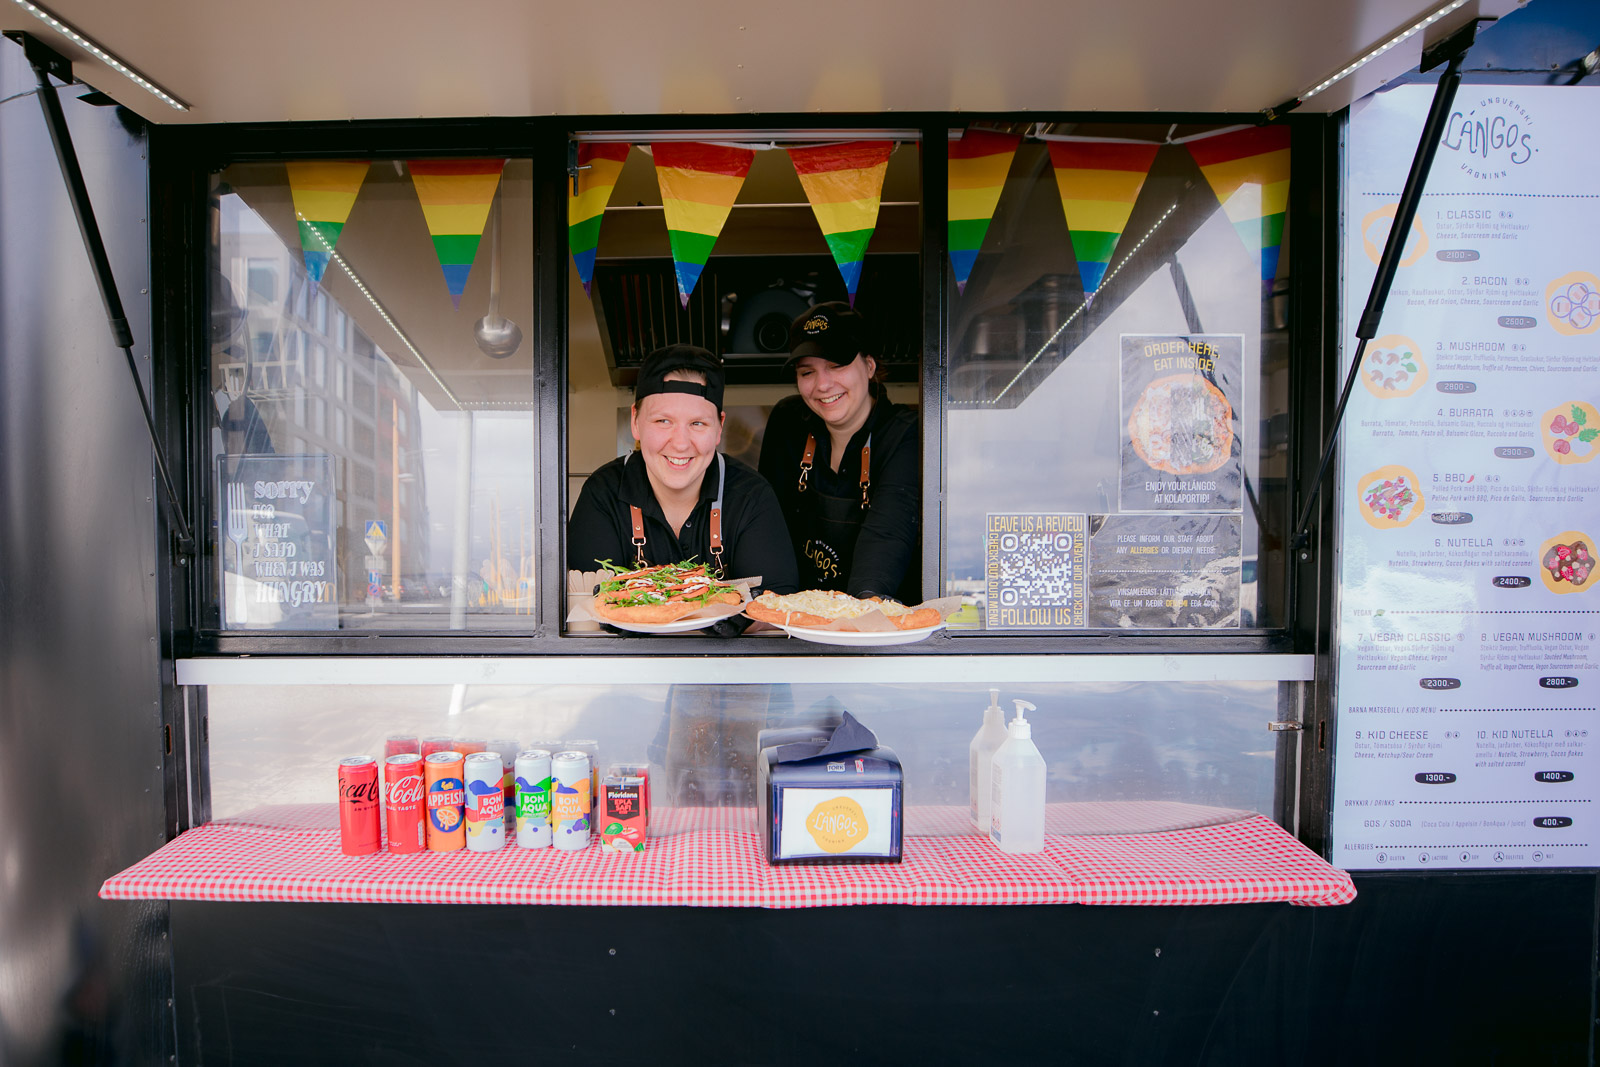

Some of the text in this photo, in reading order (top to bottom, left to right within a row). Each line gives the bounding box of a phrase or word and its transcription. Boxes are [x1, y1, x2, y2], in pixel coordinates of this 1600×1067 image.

[1480, 97, 1533, 126] UNGVERSKI
[1461, 163, 1506, 180] VAGNINN
[1447, 210, 1492, 219] CLASSIC
[1462, 276, 1507, 285] 2. BACON
[1144, 342, 1220, 359] ORDER HERE,
[1436, 342, 1505, 351] 3. MUSHROOM
[1154, 357, 1216, 372] EAT INSIDE!
[1438, 408, 1494, 417] 4. BURRATA
[1433, 474, 1465, 482] 5. BBQ
[1146, 479, 1216, 491] ENJOY YOUR LÁNGOS
[254, 480, 315, 504] sorry
[1154, 495, 1164, 504] AT
[252, 504, 275, 520] FOR
[988, 516, 1083, 532] LEAVE US A REVIEW
[254, 523, 291, 538] WHAT
[1178, 534, 1193, 542] STAFF
[1434, 538, 1492, 547] 6. NUTELLA
[264, 542, 297, 558] SAID
[254, 561, 287, 577] WHEN
[300, 560, 325, 577] WAS
[988, 533, 999, 626] CHECK OUT OUR MENU
[1074, 533, 1083, 626] CHECK OUT OUR EVENTS
[255, 580, 327, 608] HUNGRY
[1001, 608, 1071, 625] FOLLOW US
[1370, 633, 1404, 641] VEGAN
[1407, 633, 1451, 641] CLASSIC
[1481, 633, 1582, 641] 8. VEGAN MUSHROOM
[1355, 730, 1429, 740] 9. KID CHEESE
[1492, 730, 1508, 739] KID
[1512, 729, 1553, 738] NUTELLA
[483, 795, 502, 806] BON
[524, 795, 544, 804] BON
[559, 797, 578, 805] BON
[480, 803, 503, 816] AQUA
[522, 803, 547, 813] AQUA
[557, 806, 582, 815] AQUA
